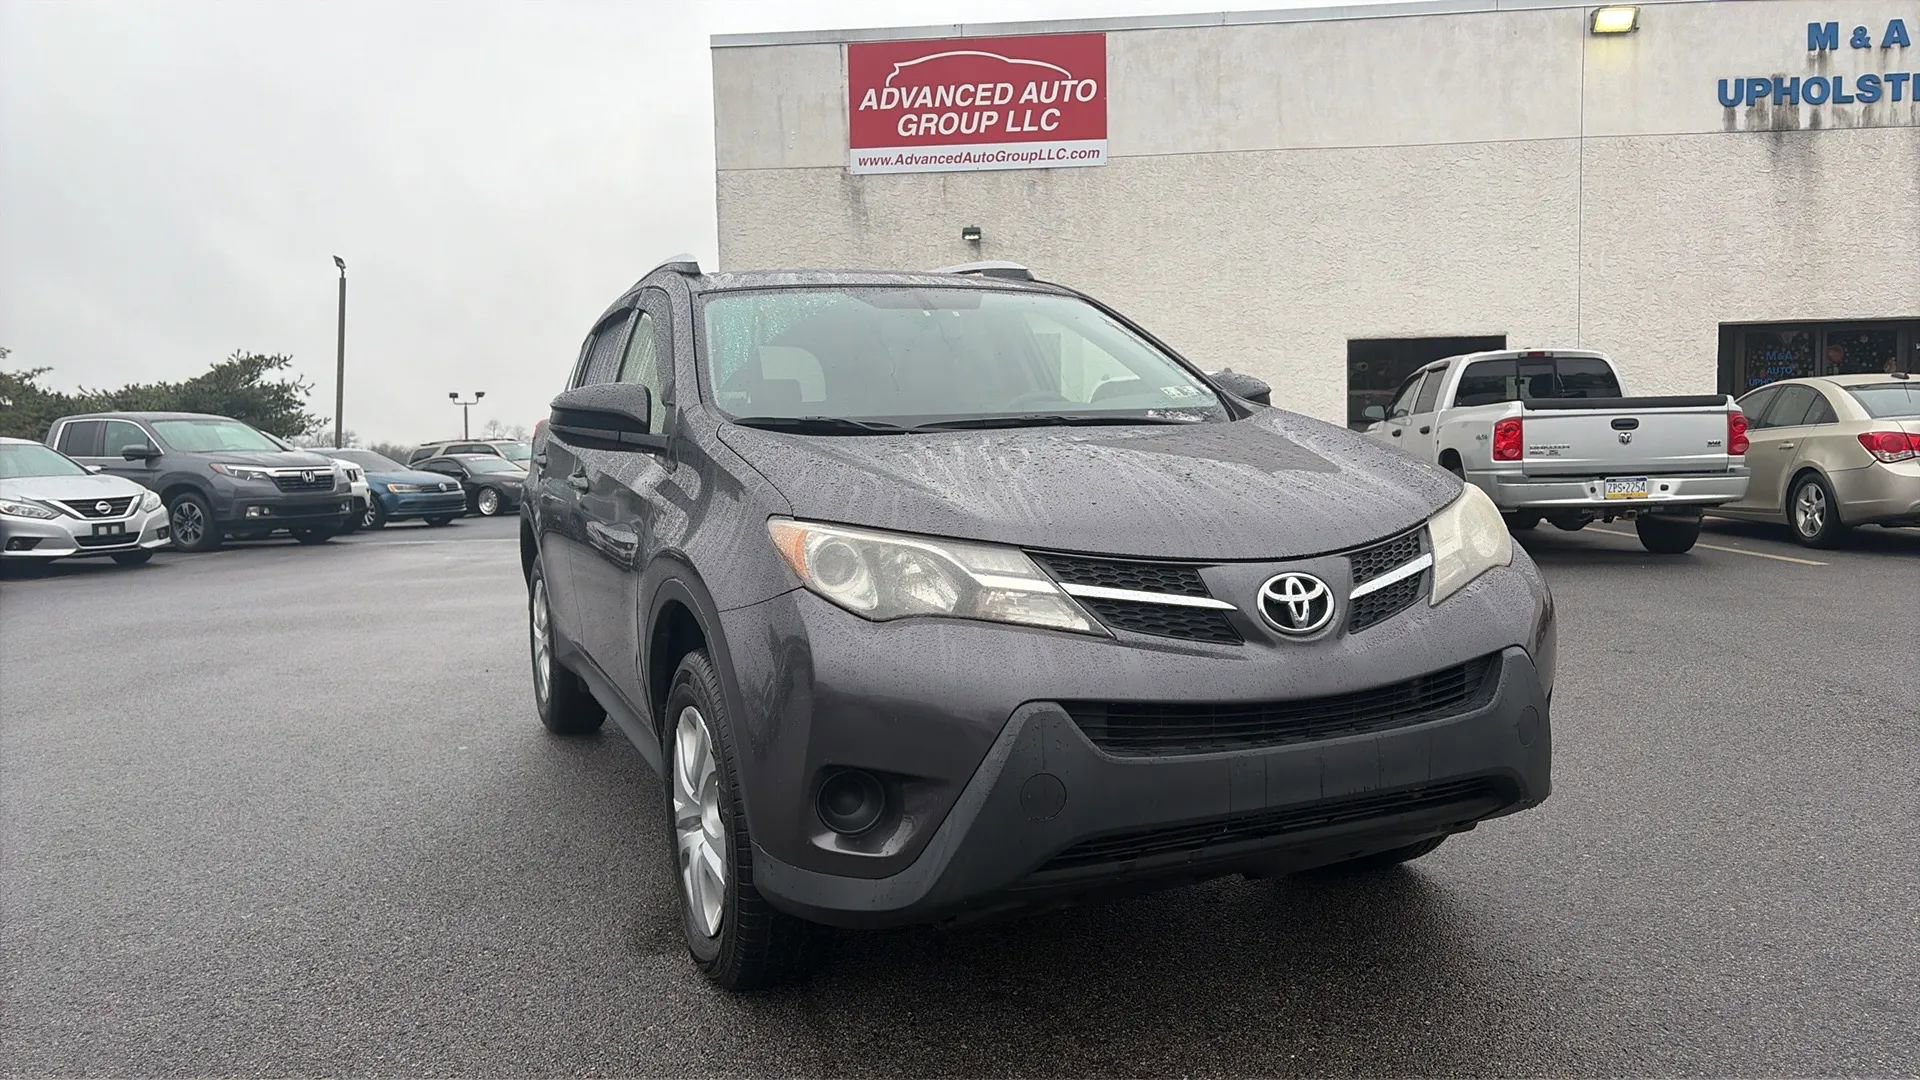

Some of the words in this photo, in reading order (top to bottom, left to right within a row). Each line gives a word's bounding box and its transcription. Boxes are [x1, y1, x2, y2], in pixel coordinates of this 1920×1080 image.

[1807, 21, 1840, 51] M
[1850, 25, 1872, 50] &
[1880, 18, 1911, 49] A
[859, 82, 1014, 111] ADVANCED
[1019, 78, 1098, 105] AUTO
[1717, 72, 1920, 108] UPHOLST
[897, 110, 999, 137] GROUP
[1005, 108, 1061, 133] LLC
[857, 147, 1101, 167] www.AdvancedAutoGroupLLC.com
[1767, 366, 1793, 376] AUTO
